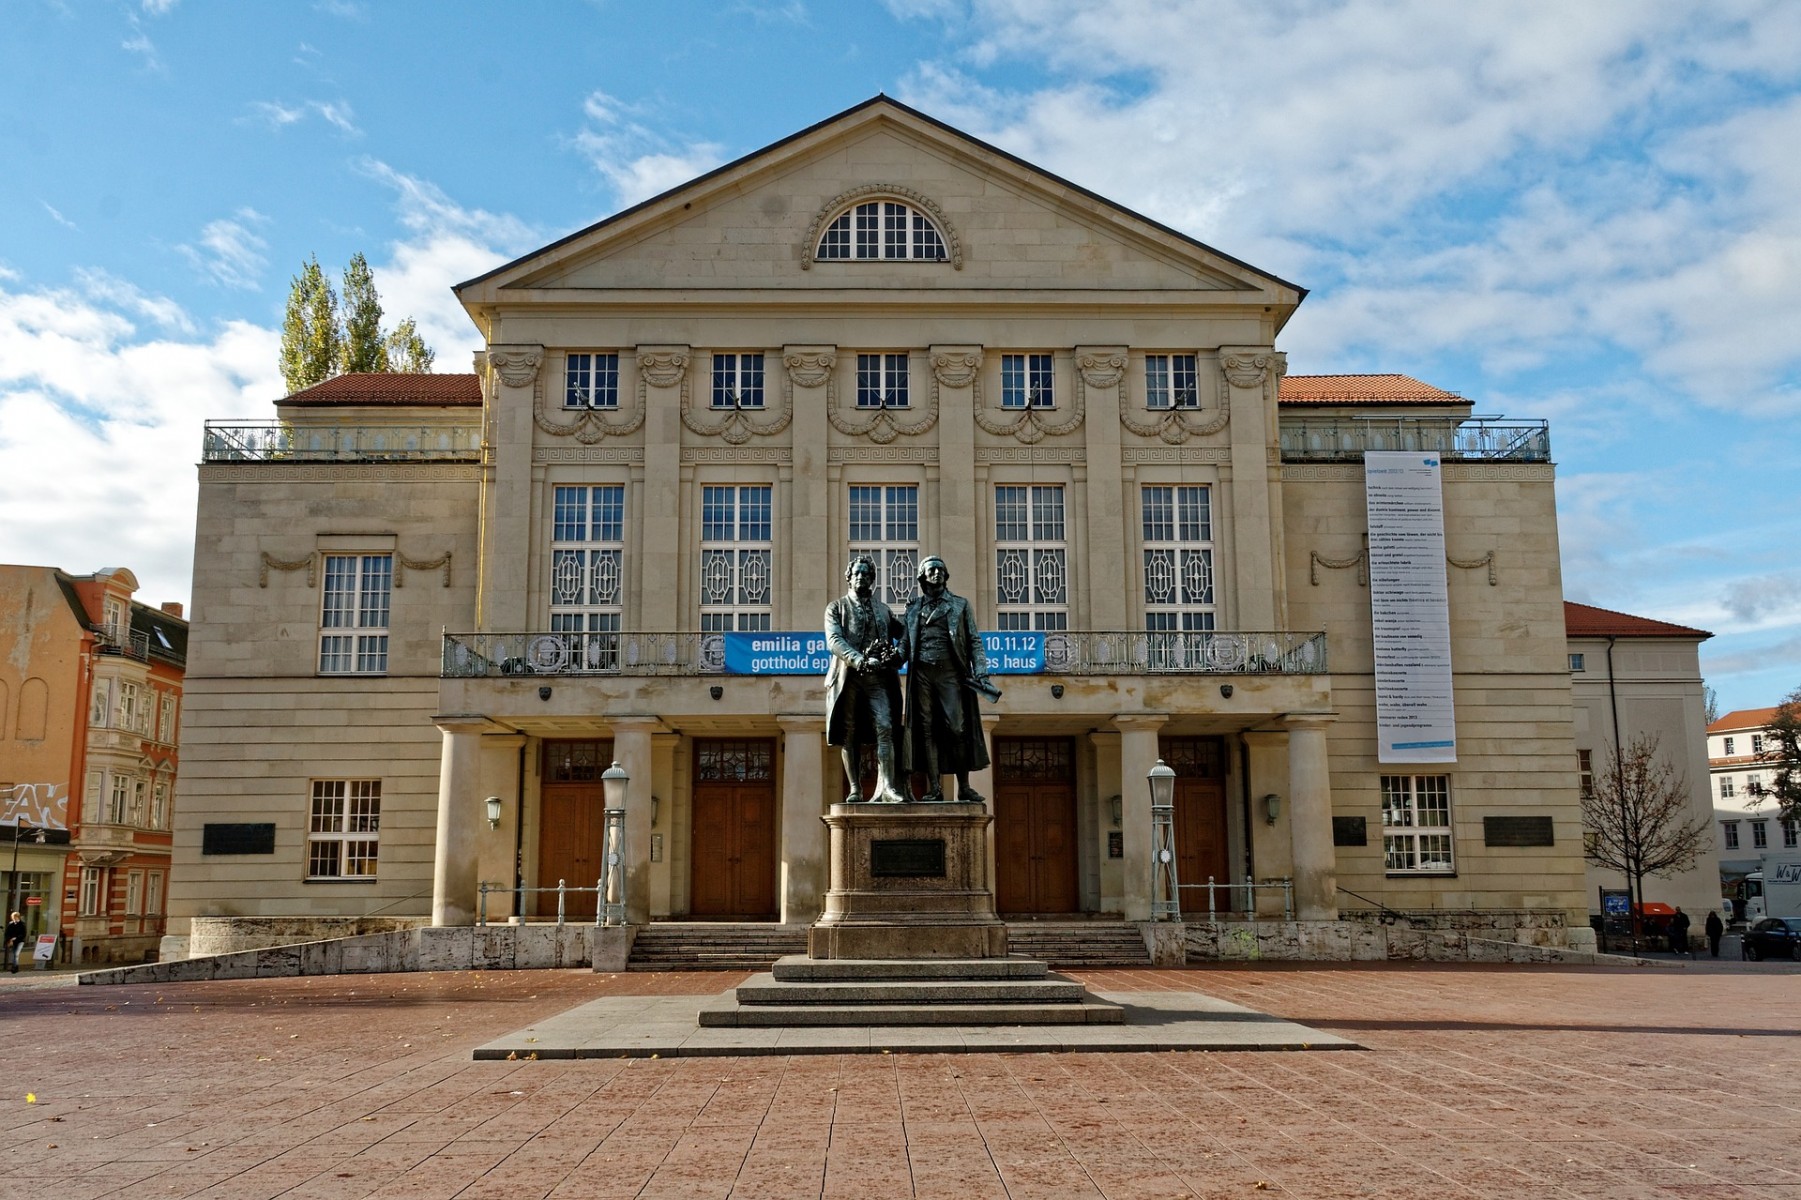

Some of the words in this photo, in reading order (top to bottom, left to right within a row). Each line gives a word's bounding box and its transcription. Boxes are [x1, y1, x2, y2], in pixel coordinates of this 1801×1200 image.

[752, 637, 801, 652] emilia
[986, 637, 1036, 651] 10.11.12
[752, 655, 808, 673] gotthold
[1004, 654, 1037, 669] haus
